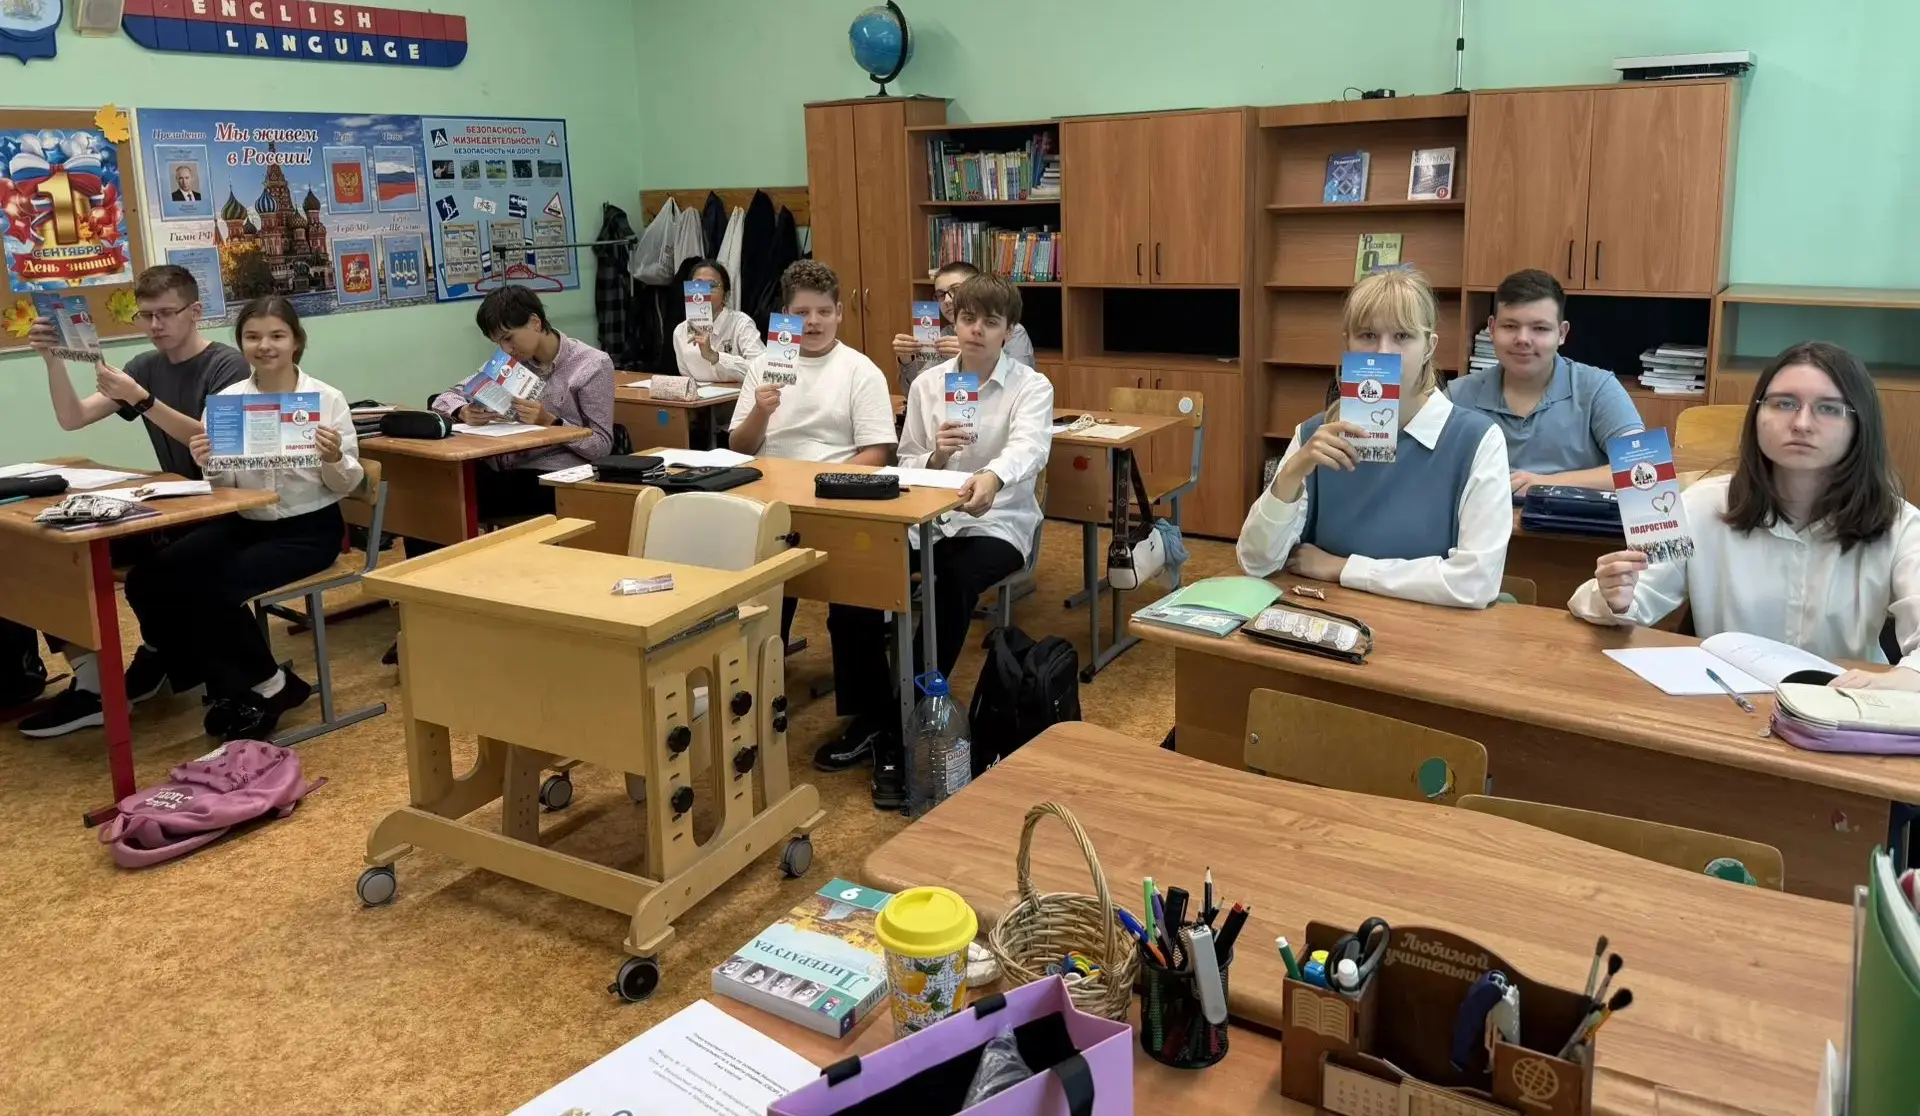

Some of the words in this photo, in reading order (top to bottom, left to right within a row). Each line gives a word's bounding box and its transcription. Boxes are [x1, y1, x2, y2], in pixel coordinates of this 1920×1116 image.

[192, 0, 371, 28] ENGLISH
[226, 30, 420, 60] LANGUAGE
[214, 122, 250, 142] Мы
[253, 128, 318, 142] живем
[466, 126, 527, 134] БЕЗОПАСНОСТЬ
[453, 136, 540, 145] ЖИЗНЕДЕЯТЕЛЬНОСТИ
[227, 153, 238, 166] в
[242, 147, 312, 166] России!
[454, 147, 505, 155] БЕЗОПАСНОСТЬ
[170, 232, 195, 241] Гимн
[33, 245, 104, 258] СЕНТЯБРЯ
[23, 259, 60, 274] День
[66, 254, 116, 271] знаний
[1630, 520, 1679, 535] ПОДРОСТКОВ
[1400, 932, 1490, 969] Любимой
[754, 938, 870, 992] ЛИТЕРАТУРА
[1384, 947, 1482, 983] учительни
